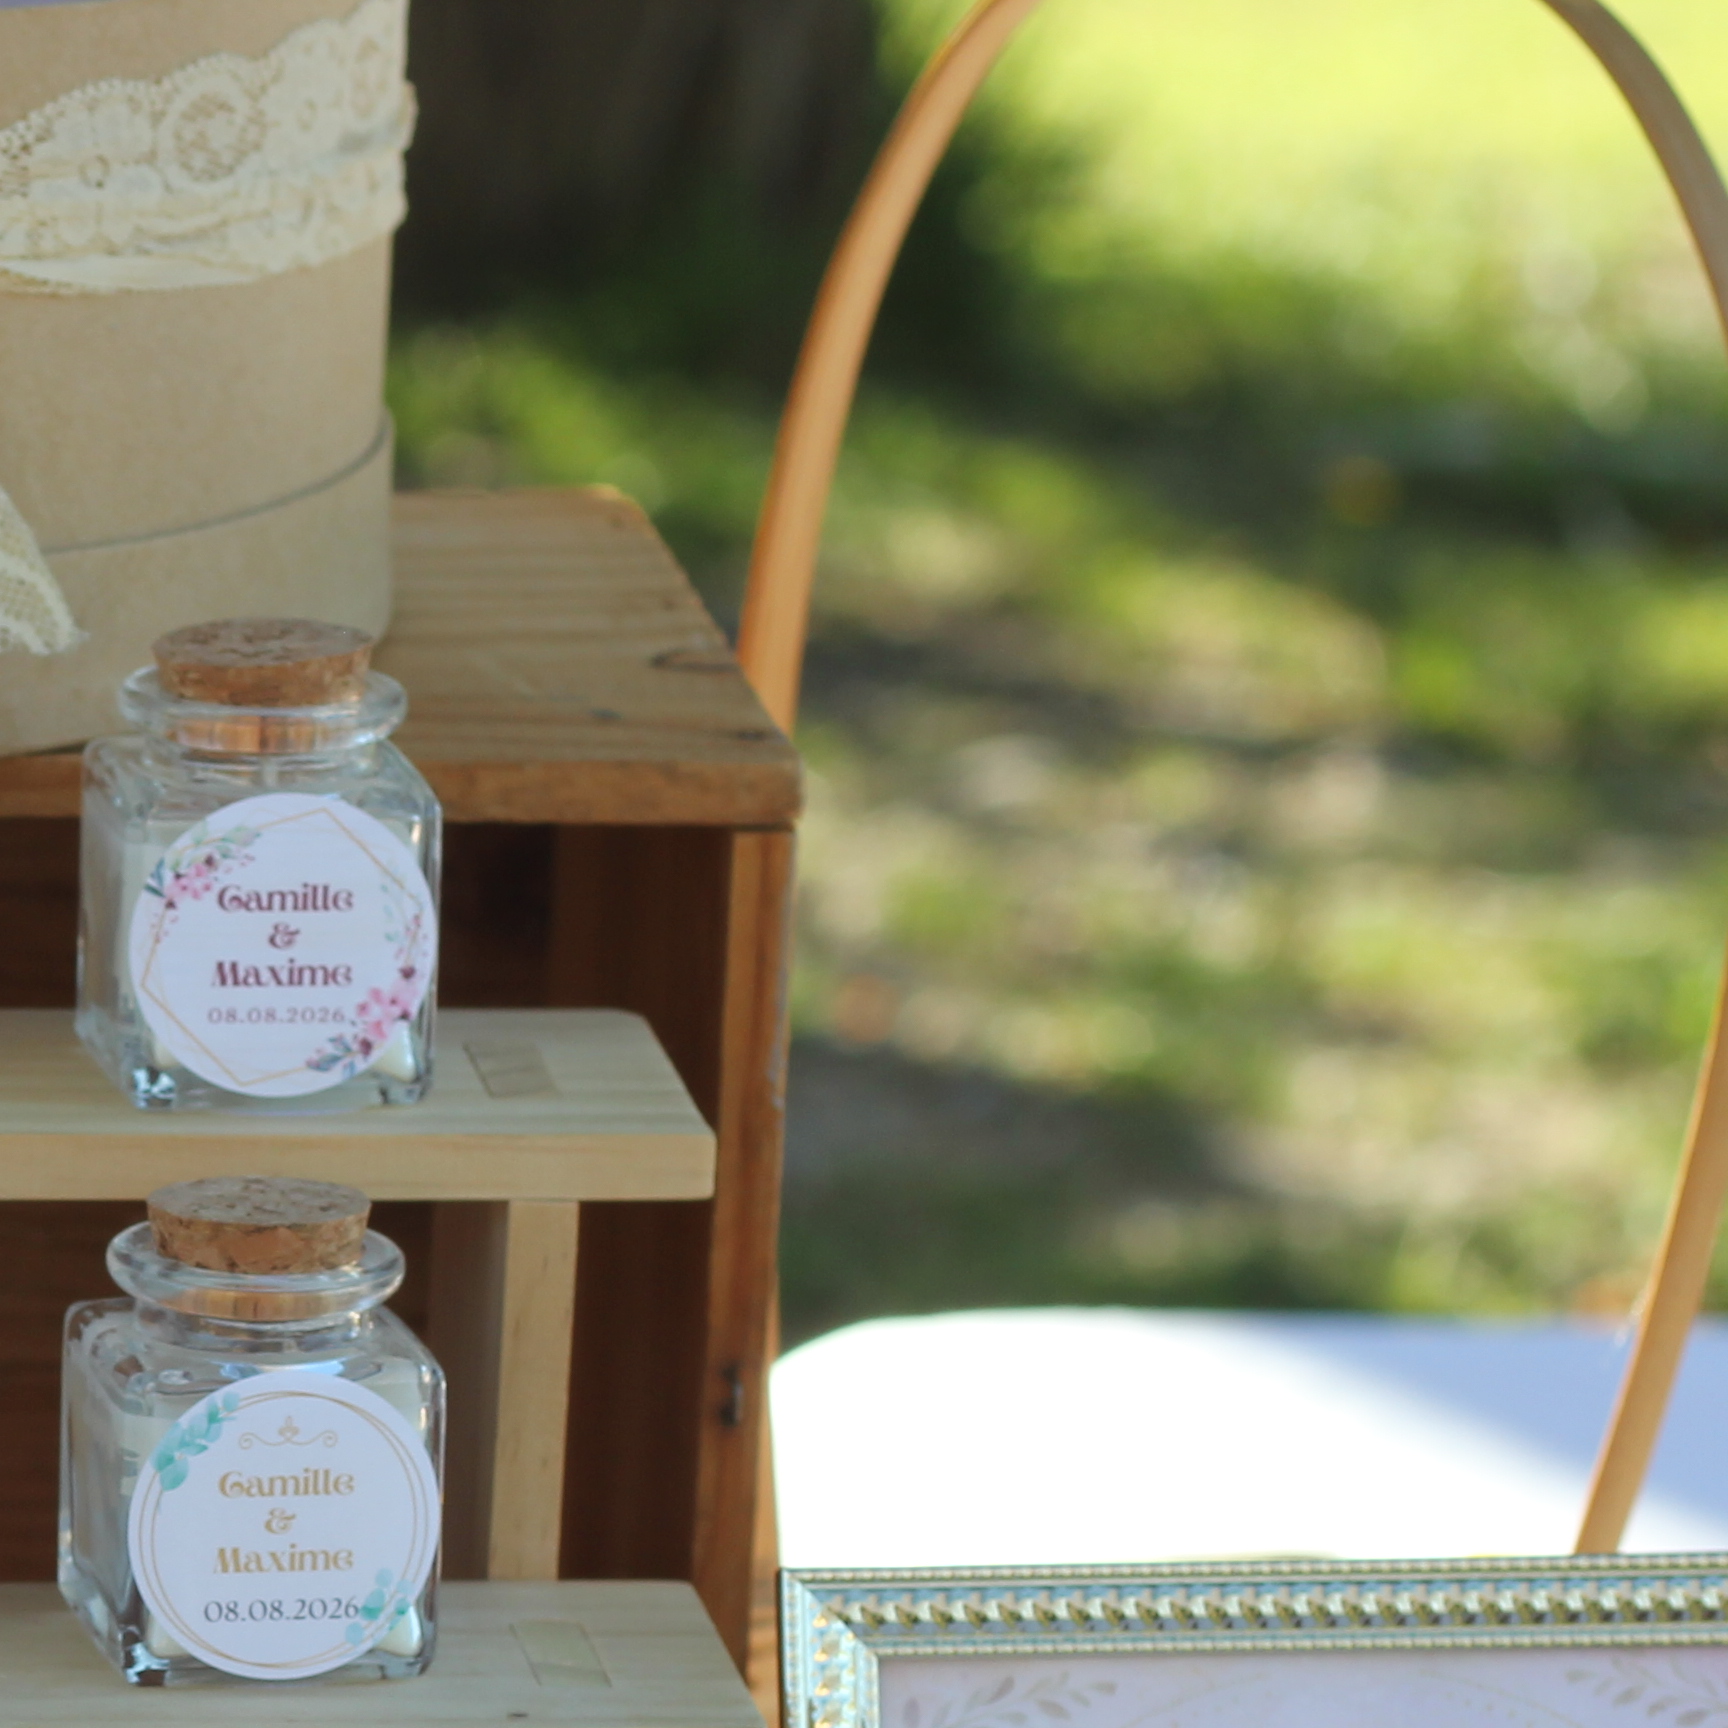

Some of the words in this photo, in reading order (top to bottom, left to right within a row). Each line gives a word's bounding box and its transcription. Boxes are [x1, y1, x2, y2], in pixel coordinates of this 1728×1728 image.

[217, 882, 353, 914] Camille
[267, 922, 299, 949] &
[211, 959, 352, 989] Maxime
[207, 1006, 345, 1024] 08.08.2026
[218, 1469, 354, 1498] Camille
[264, 1507, 297, 1534] &
[213, 1544, 354, 1573] Maxime
[203, 1598, 360, 1624] 08.08.2026
